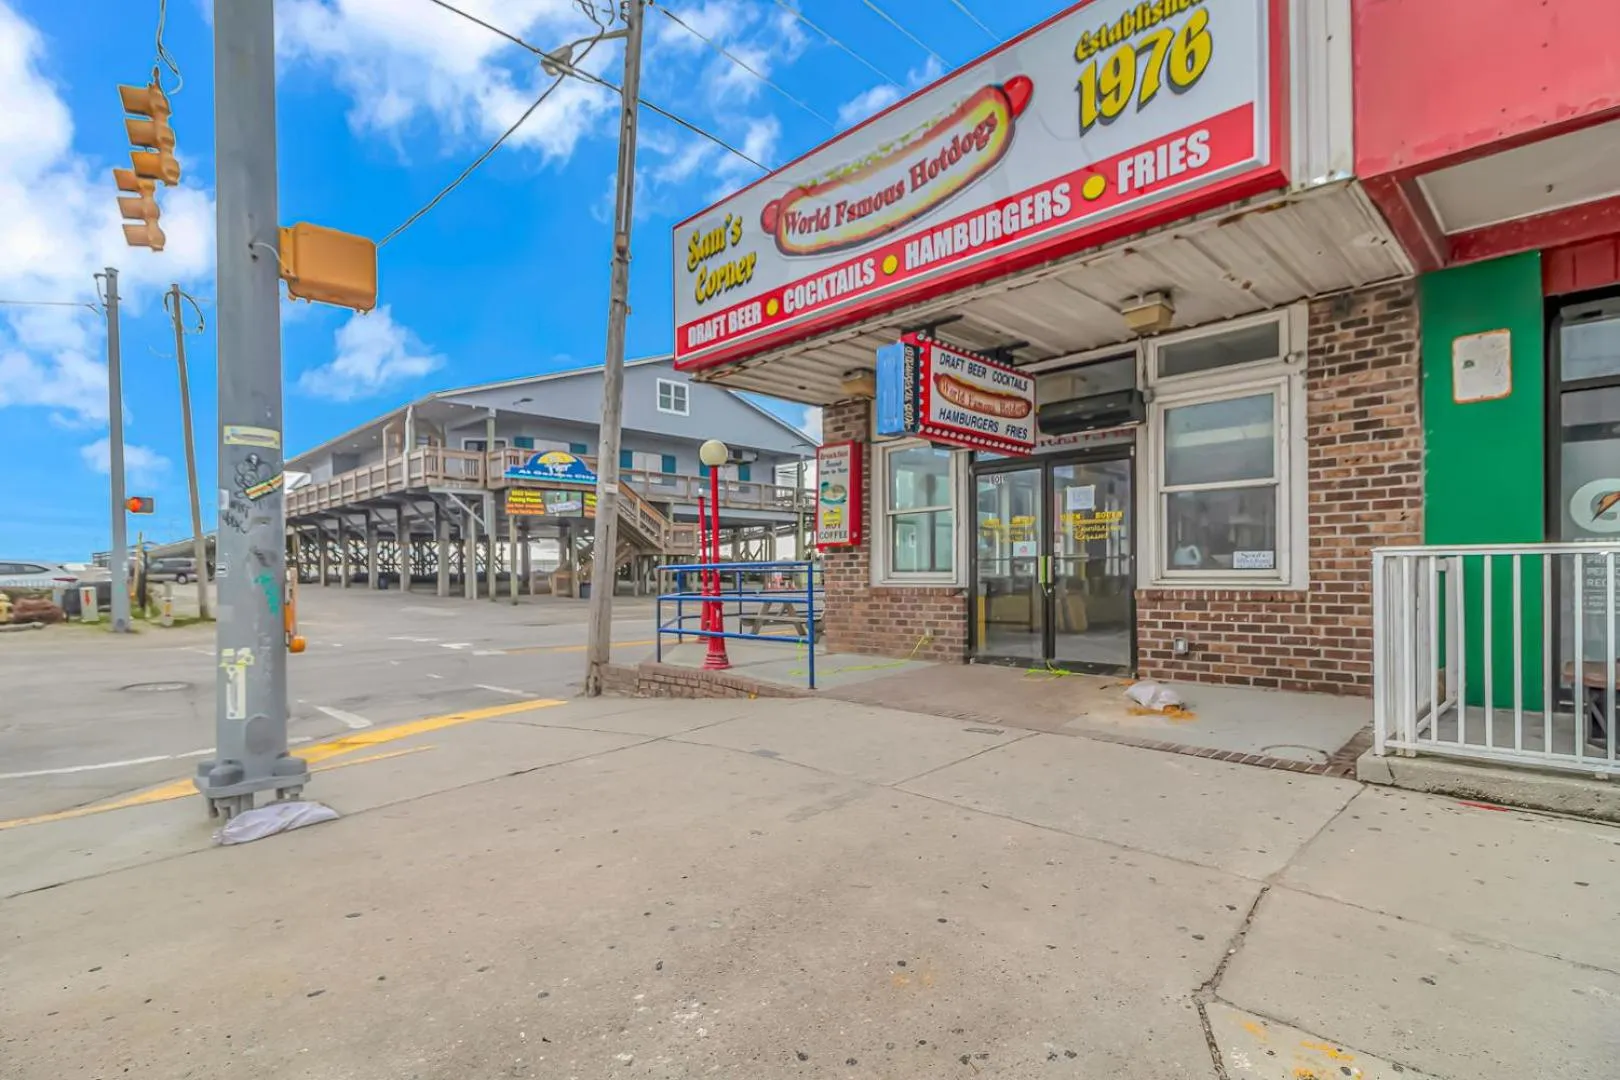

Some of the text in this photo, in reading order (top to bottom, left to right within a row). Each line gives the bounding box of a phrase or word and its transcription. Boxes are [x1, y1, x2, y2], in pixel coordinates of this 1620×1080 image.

[1074, 0, 1203, 63] Establishe
[1075, 8, 1212, 137] 1976
[784, 110, 998, 236] World Famous Hotdogs
[687, 212, 742, 273] Sam's
[688, 129, 1211, 348] DRAFT BEER COCKTAILS HAMBURGERS FRIES
[695, 251, 757, 306] Corner
[939, 352, 1029, 392] DRAFT BEER COCKTAILS
[939, 407, 1000, 433] HAMBURGERS
[1005, 424, 1029, 440] FRIES
[819, 529, 848, 540] COFFEE
